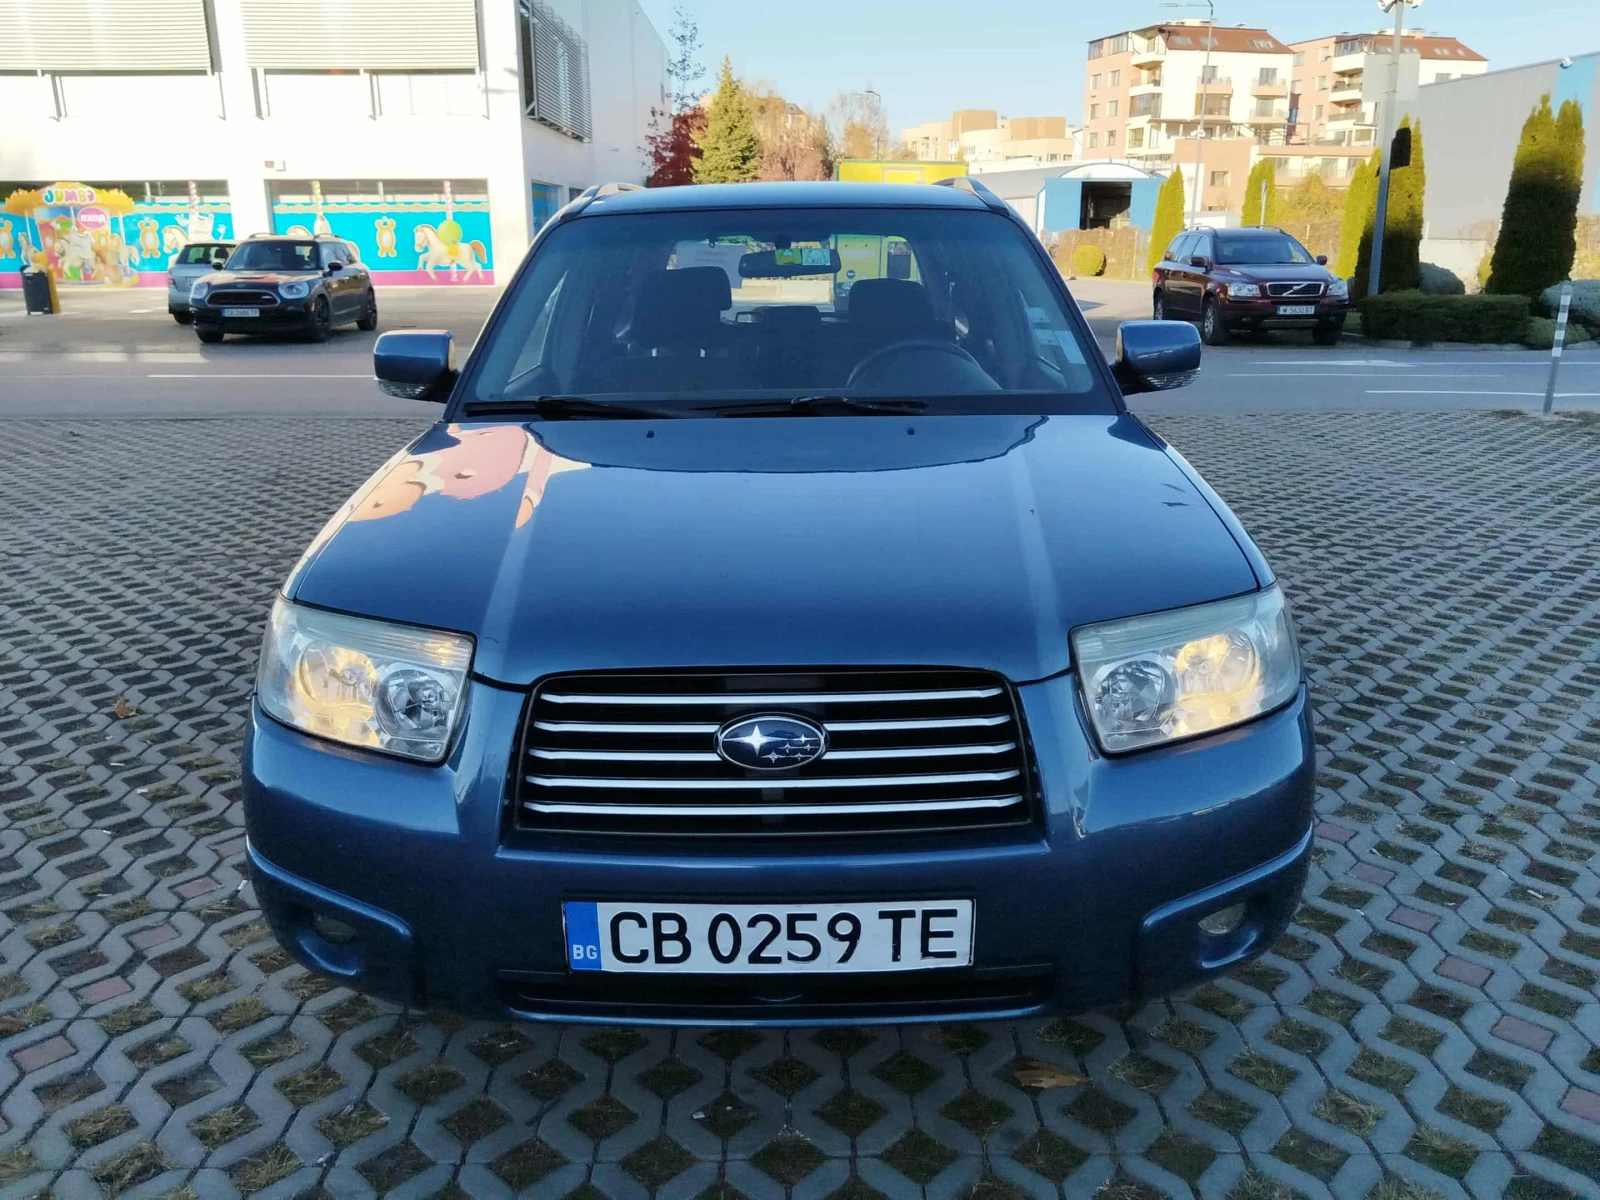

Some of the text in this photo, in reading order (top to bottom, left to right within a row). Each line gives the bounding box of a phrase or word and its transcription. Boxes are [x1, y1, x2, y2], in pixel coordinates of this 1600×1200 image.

[572, 944, 598, 960] BG
[610, 909, 958, 965] CB 0259 TE
